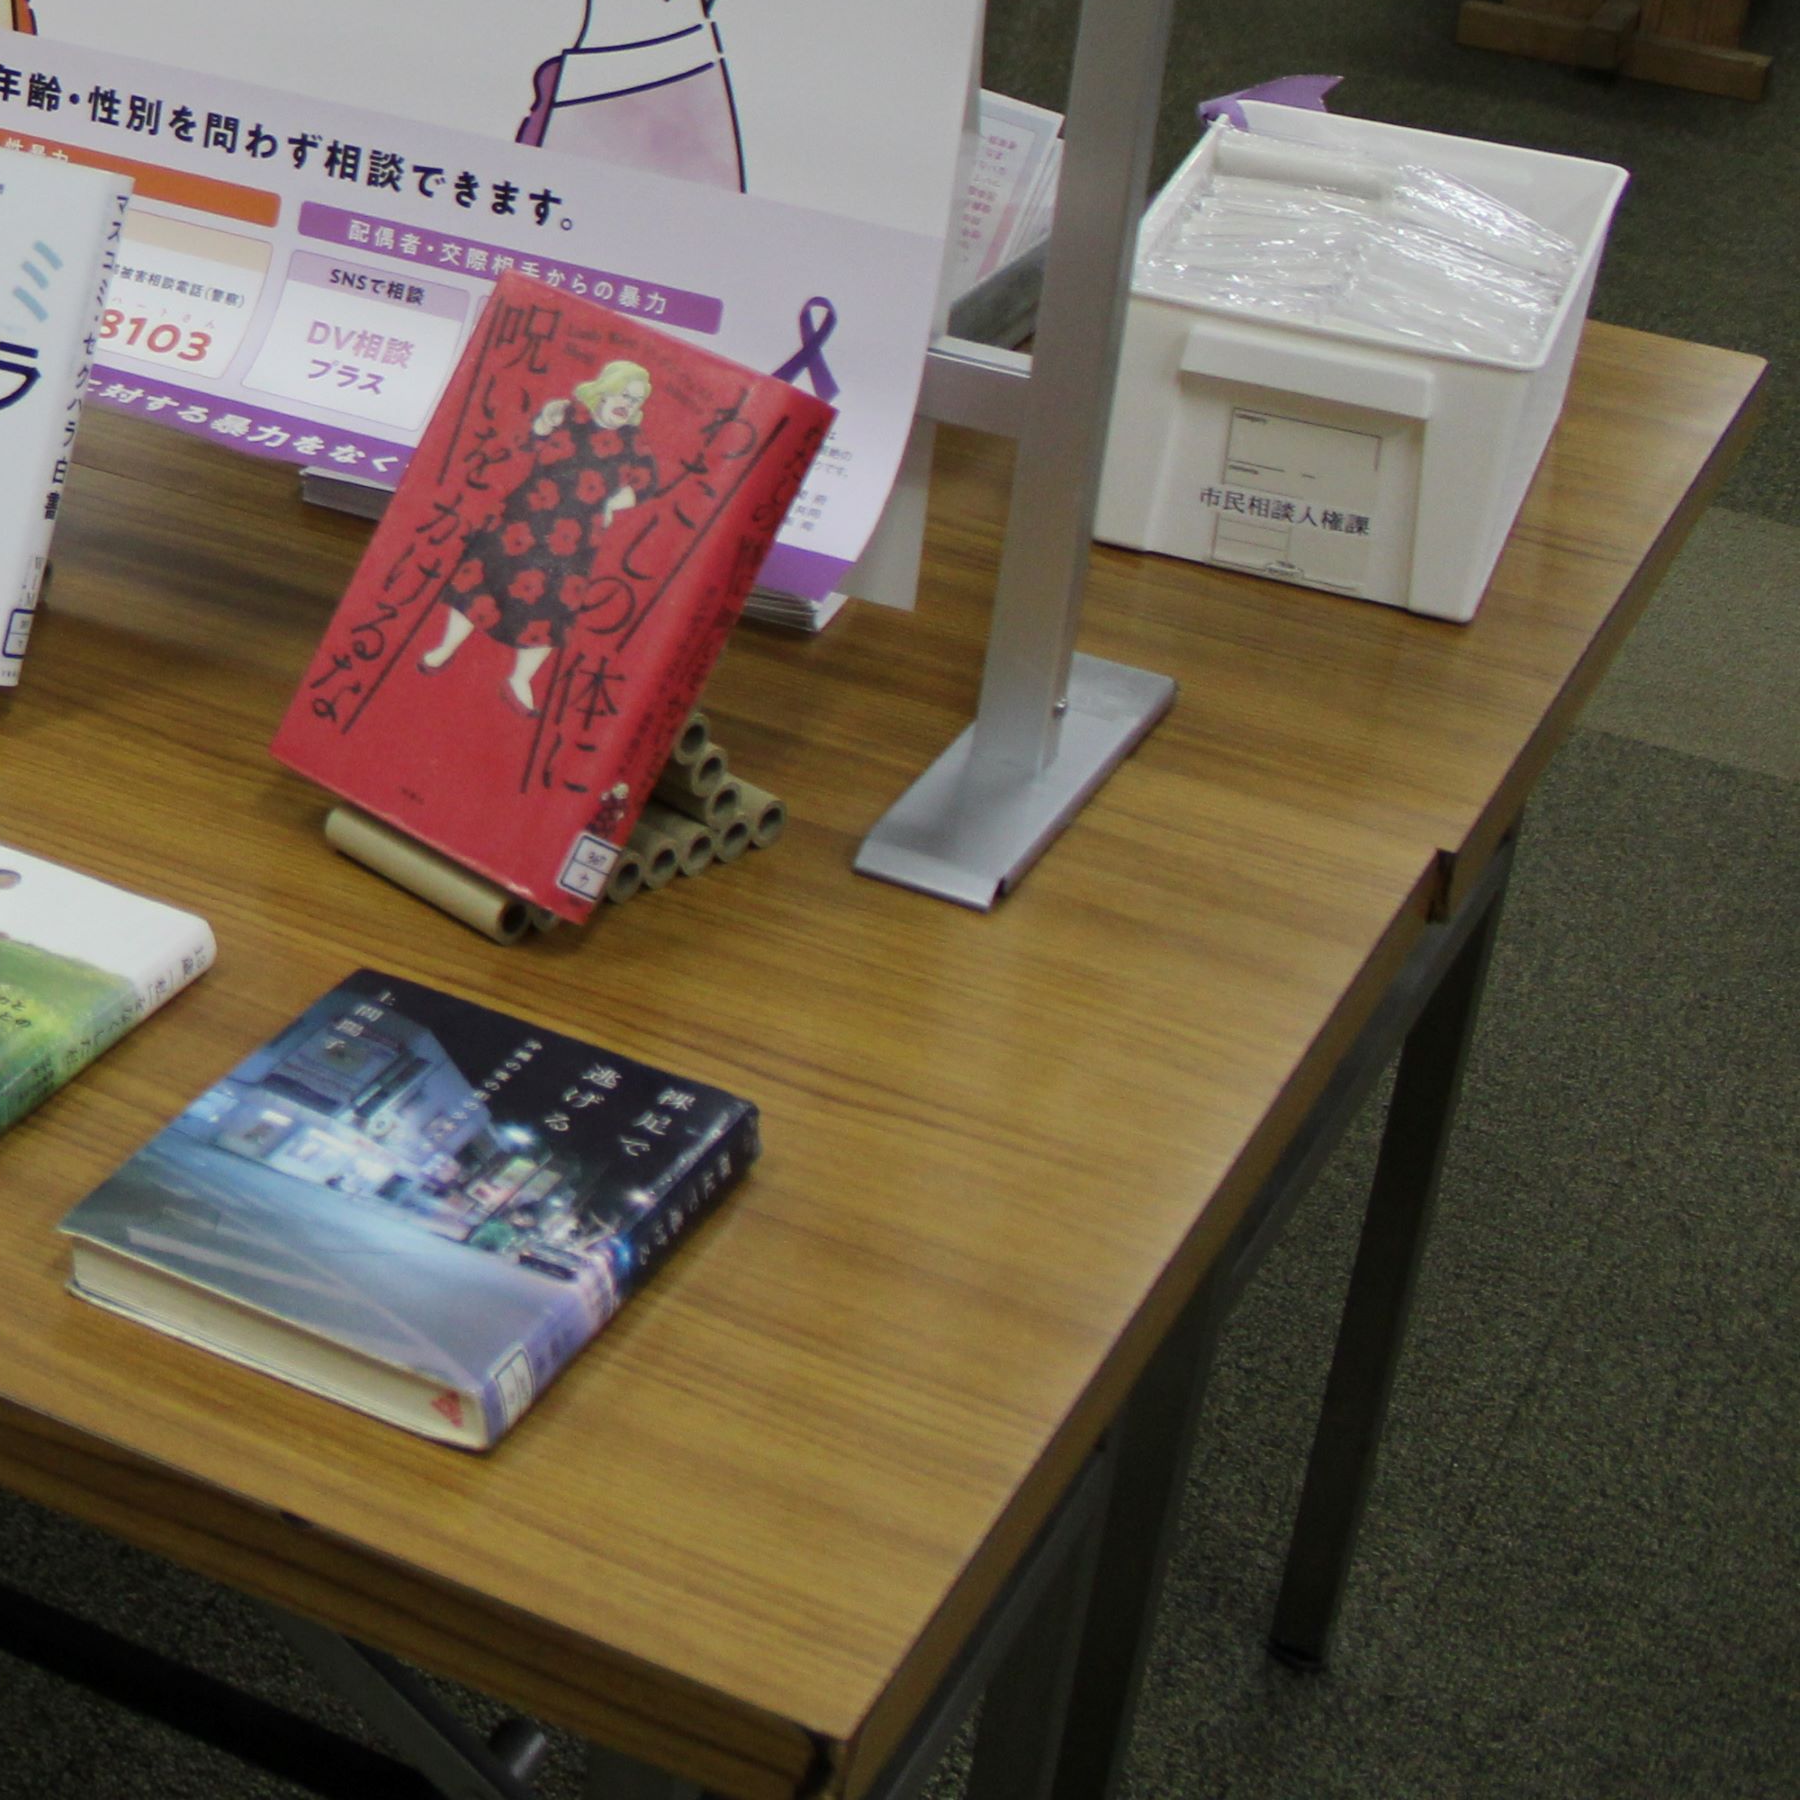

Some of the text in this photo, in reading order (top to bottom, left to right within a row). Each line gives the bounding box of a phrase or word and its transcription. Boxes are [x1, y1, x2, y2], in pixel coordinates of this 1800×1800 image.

[328, 267, 425, 306] SNSで相談
[306, 319, 415, 369] DV相談
[306, 357, 385, 395] プラス
[1199, 487, 1372, 536] 市民相談人権課
